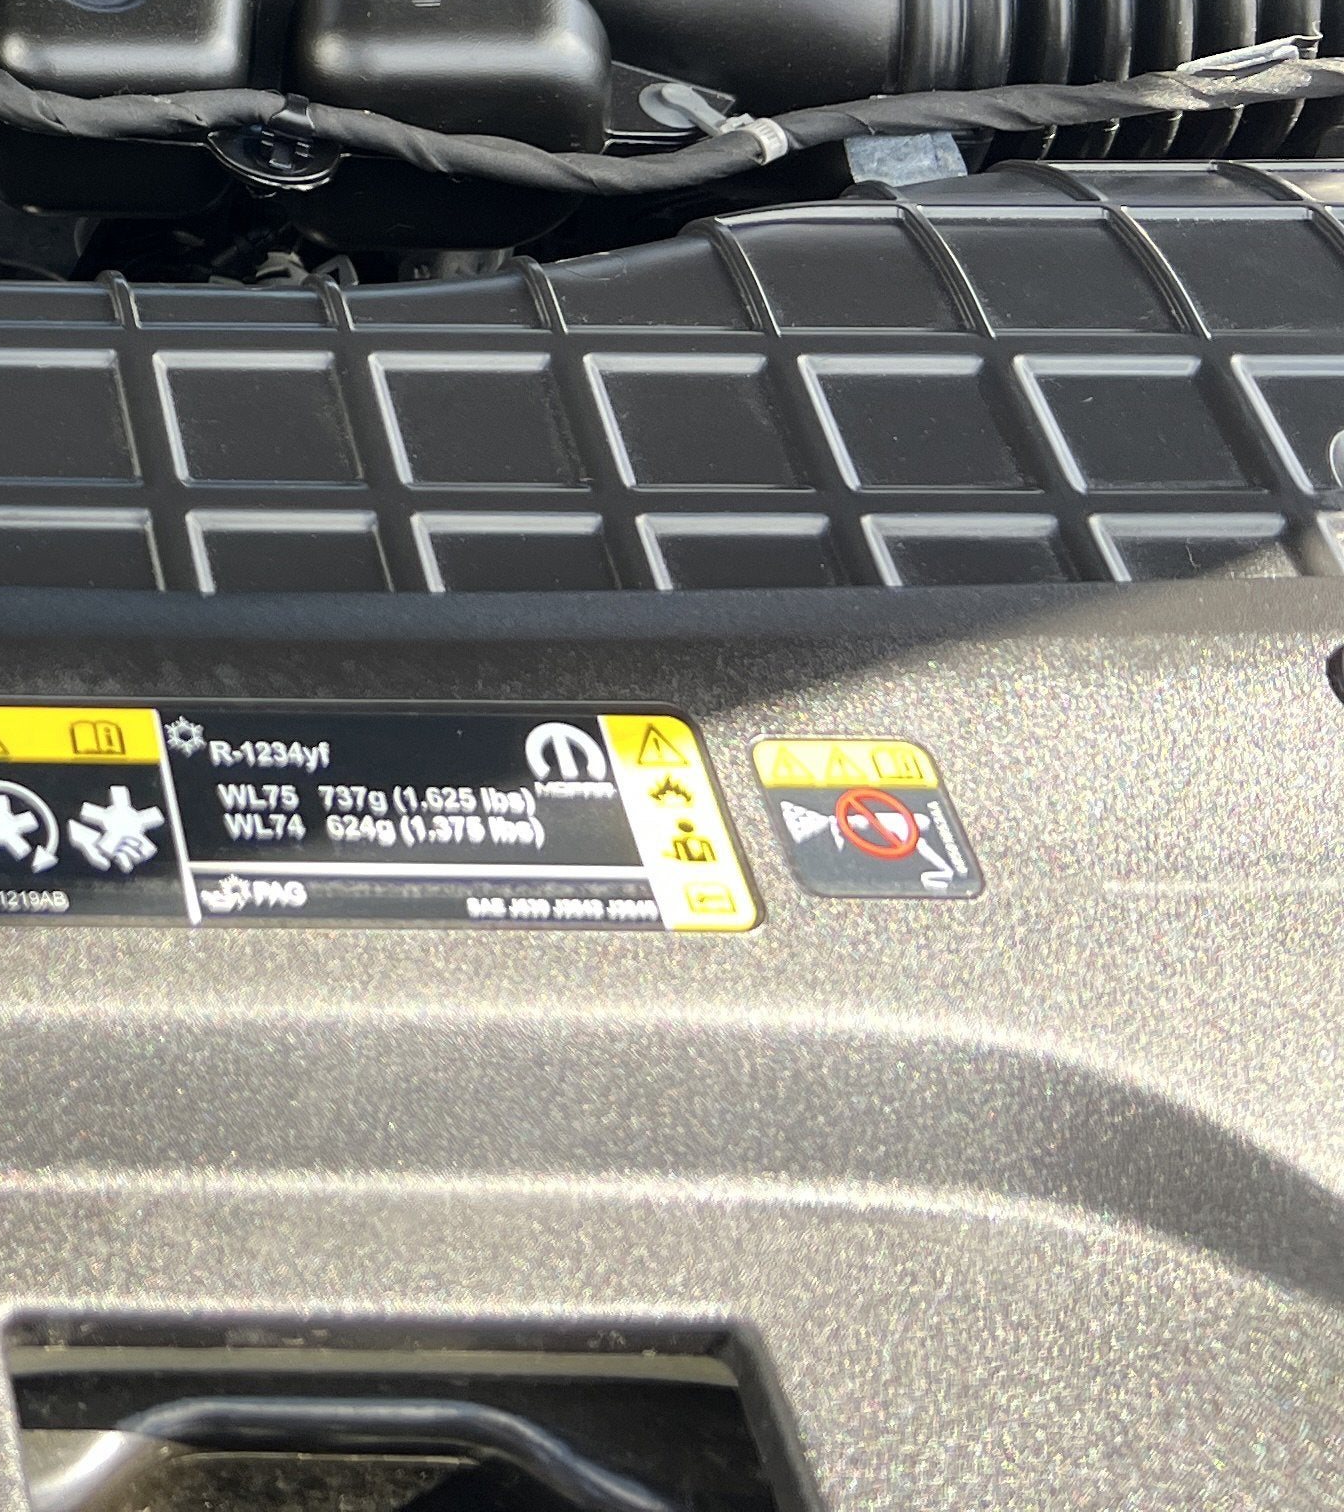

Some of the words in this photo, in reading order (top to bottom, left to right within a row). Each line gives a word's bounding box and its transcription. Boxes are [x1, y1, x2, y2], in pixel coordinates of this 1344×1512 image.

[209, 740, 330, 773] R-1234yf
[217, 784, 300, 811] WL75
[318, 785, 389, 816] 737g
[393, 785, 477, 815] (1.625
[481, 787, 536, 817] lbs)
[224, 813, 307, 841] WL74
[326, 815, 397, 847] 624g
[400, 815, 486, 848] (1.375
[489, 816, 546, 850] lbs)
